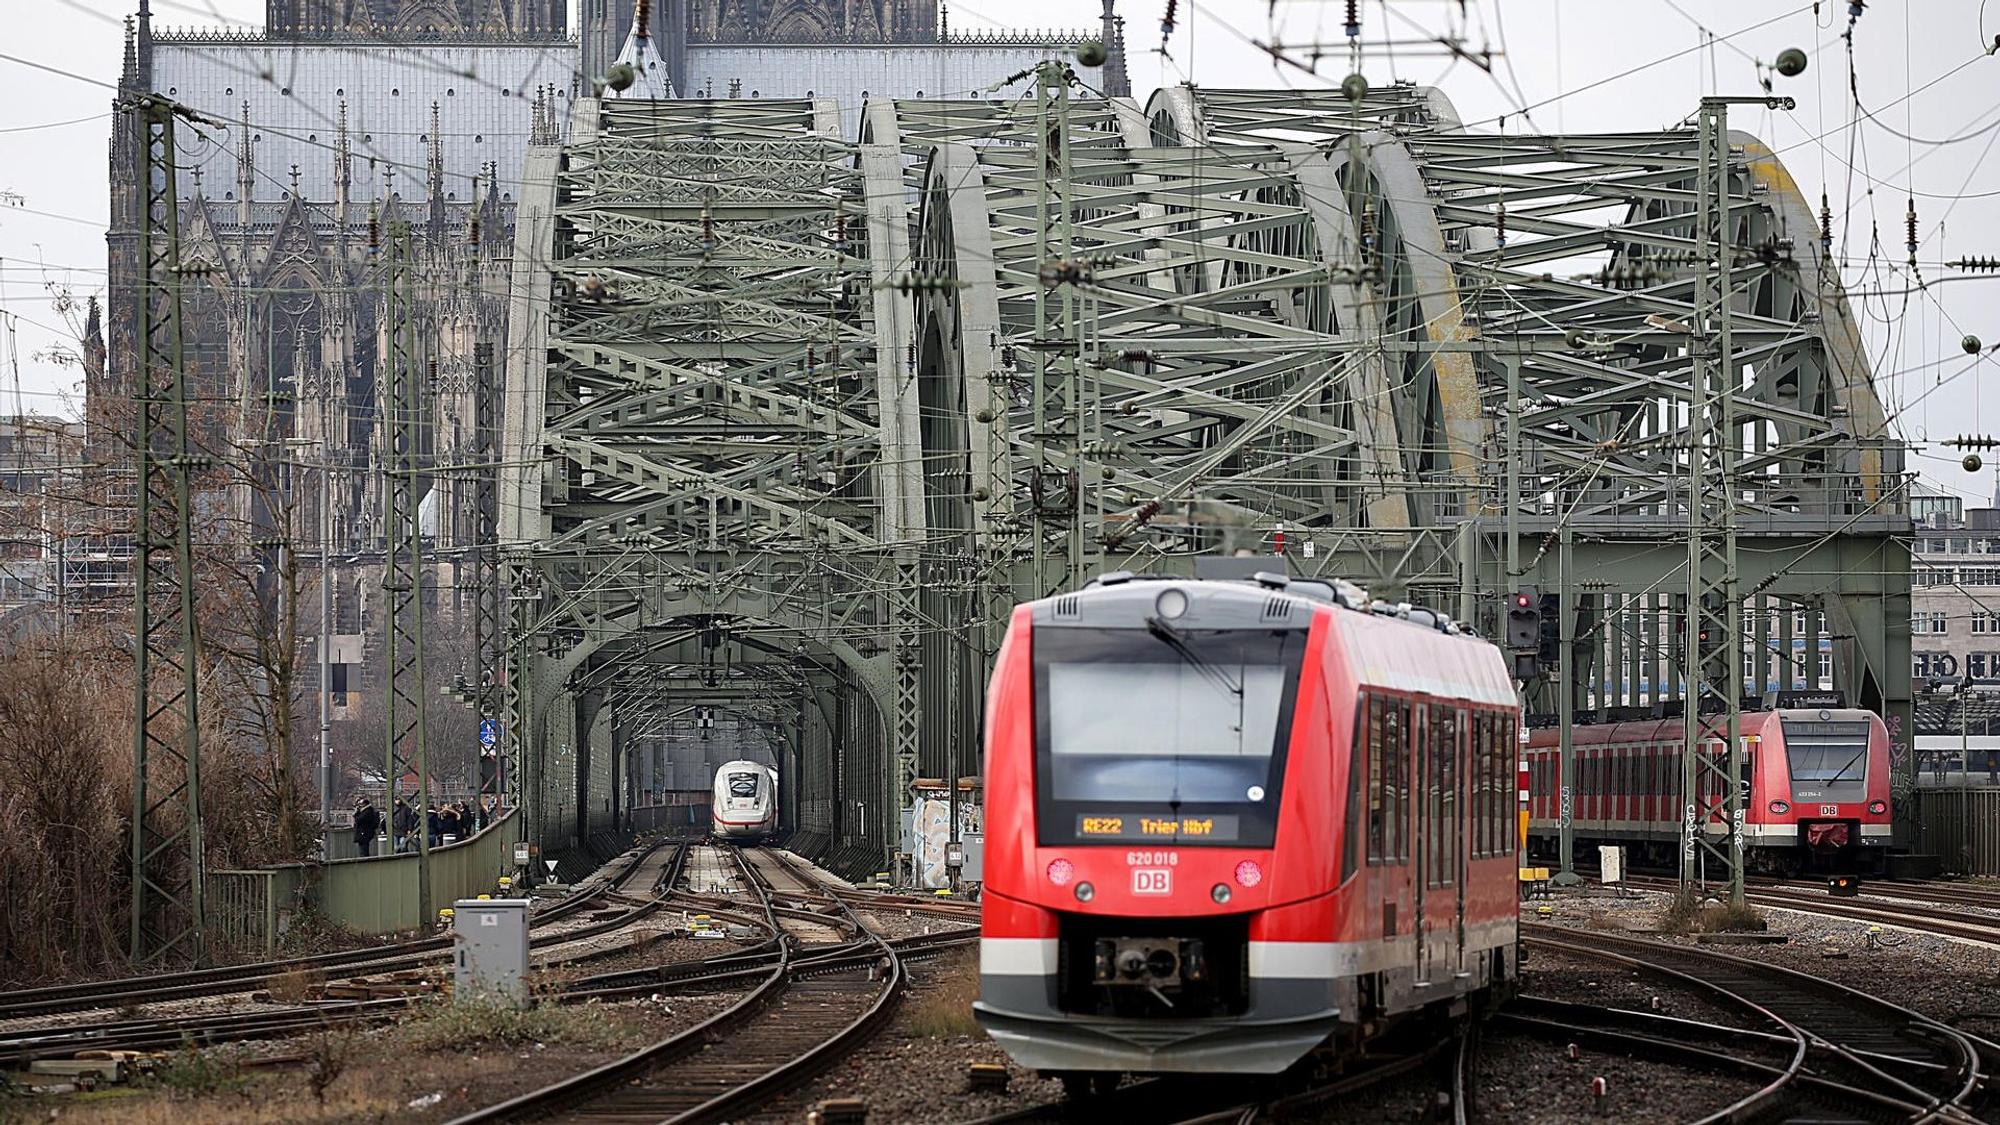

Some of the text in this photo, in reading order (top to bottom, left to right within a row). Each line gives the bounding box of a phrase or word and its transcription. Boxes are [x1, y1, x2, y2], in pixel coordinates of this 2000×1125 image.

[1822, 806, 1836, 815] DB
[1083, 817, 1213, 835] RE22 Trier Hbf
[1127, 852, 1178, 866] 620 018
[1137, 872, 1167, 890] DB
